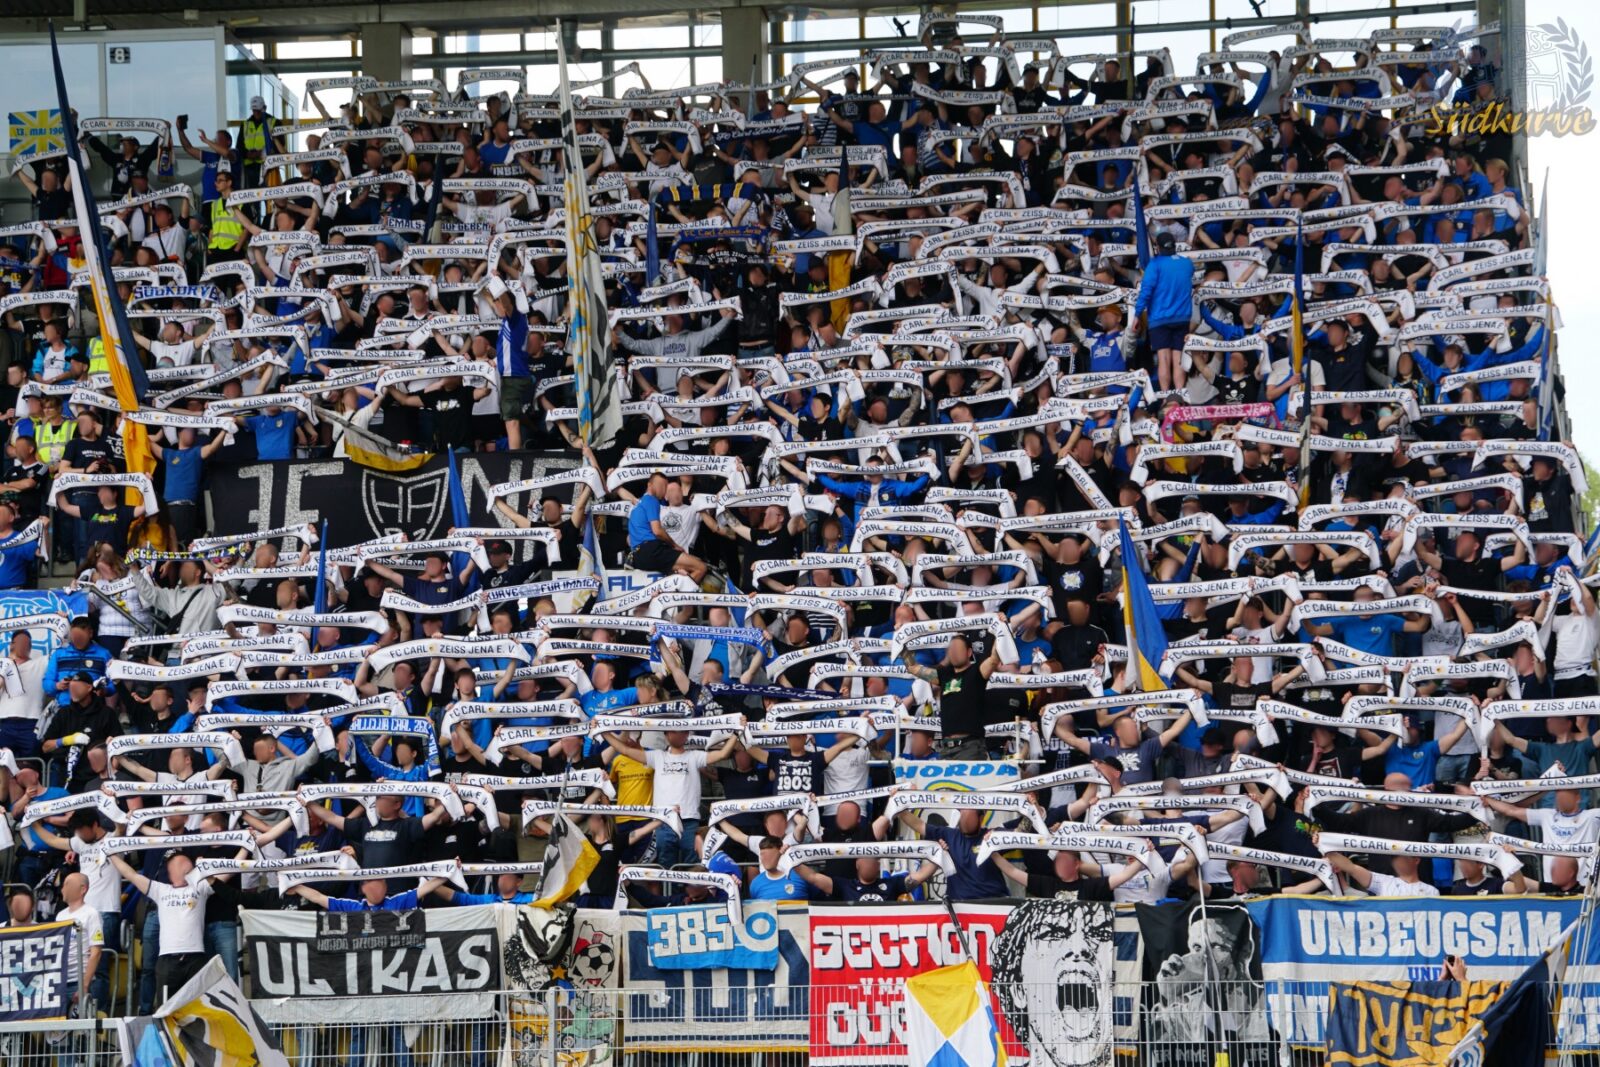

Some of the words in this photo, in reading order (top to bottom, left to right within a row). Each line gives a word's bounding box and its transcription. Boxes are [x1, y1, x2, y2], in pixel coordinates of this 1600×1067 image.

[115, 48, 125, 62] 8
[49, 127, 66, 136] 190
[895, 763, 1018, 778] HORDA
[778, 776, 812, 791] 1903
[895, 796, 906, 806] FC
[909, 794, 937, 804] CARL
[953, 795, 984, 805] ZEISS
[988, 796, 1019, 807] JENA
[1002, 837, 1035, 845] CARL
[1052, 838, 1085, 846] ZEISS
[1090, 839, 1122, 849] JENA
[1344, 839, 1357, 848] FC
[1360, 840, 1389, 850] CARL
[1405, 843, 1437, 853] ZEISS
[1441, 844, 1471, 855] JENA
[789, 850, 802, 861] FC
[804, 847, 834, 857] CARL
[849, 846, 880, 855] ZEISS
[883, 846, 913, 855] JENA
[1298, 910, 1562, 957] UNBEUGSAM
[812, 922, 996, 969] SECTION
[0, 933, 64, 974] EES
